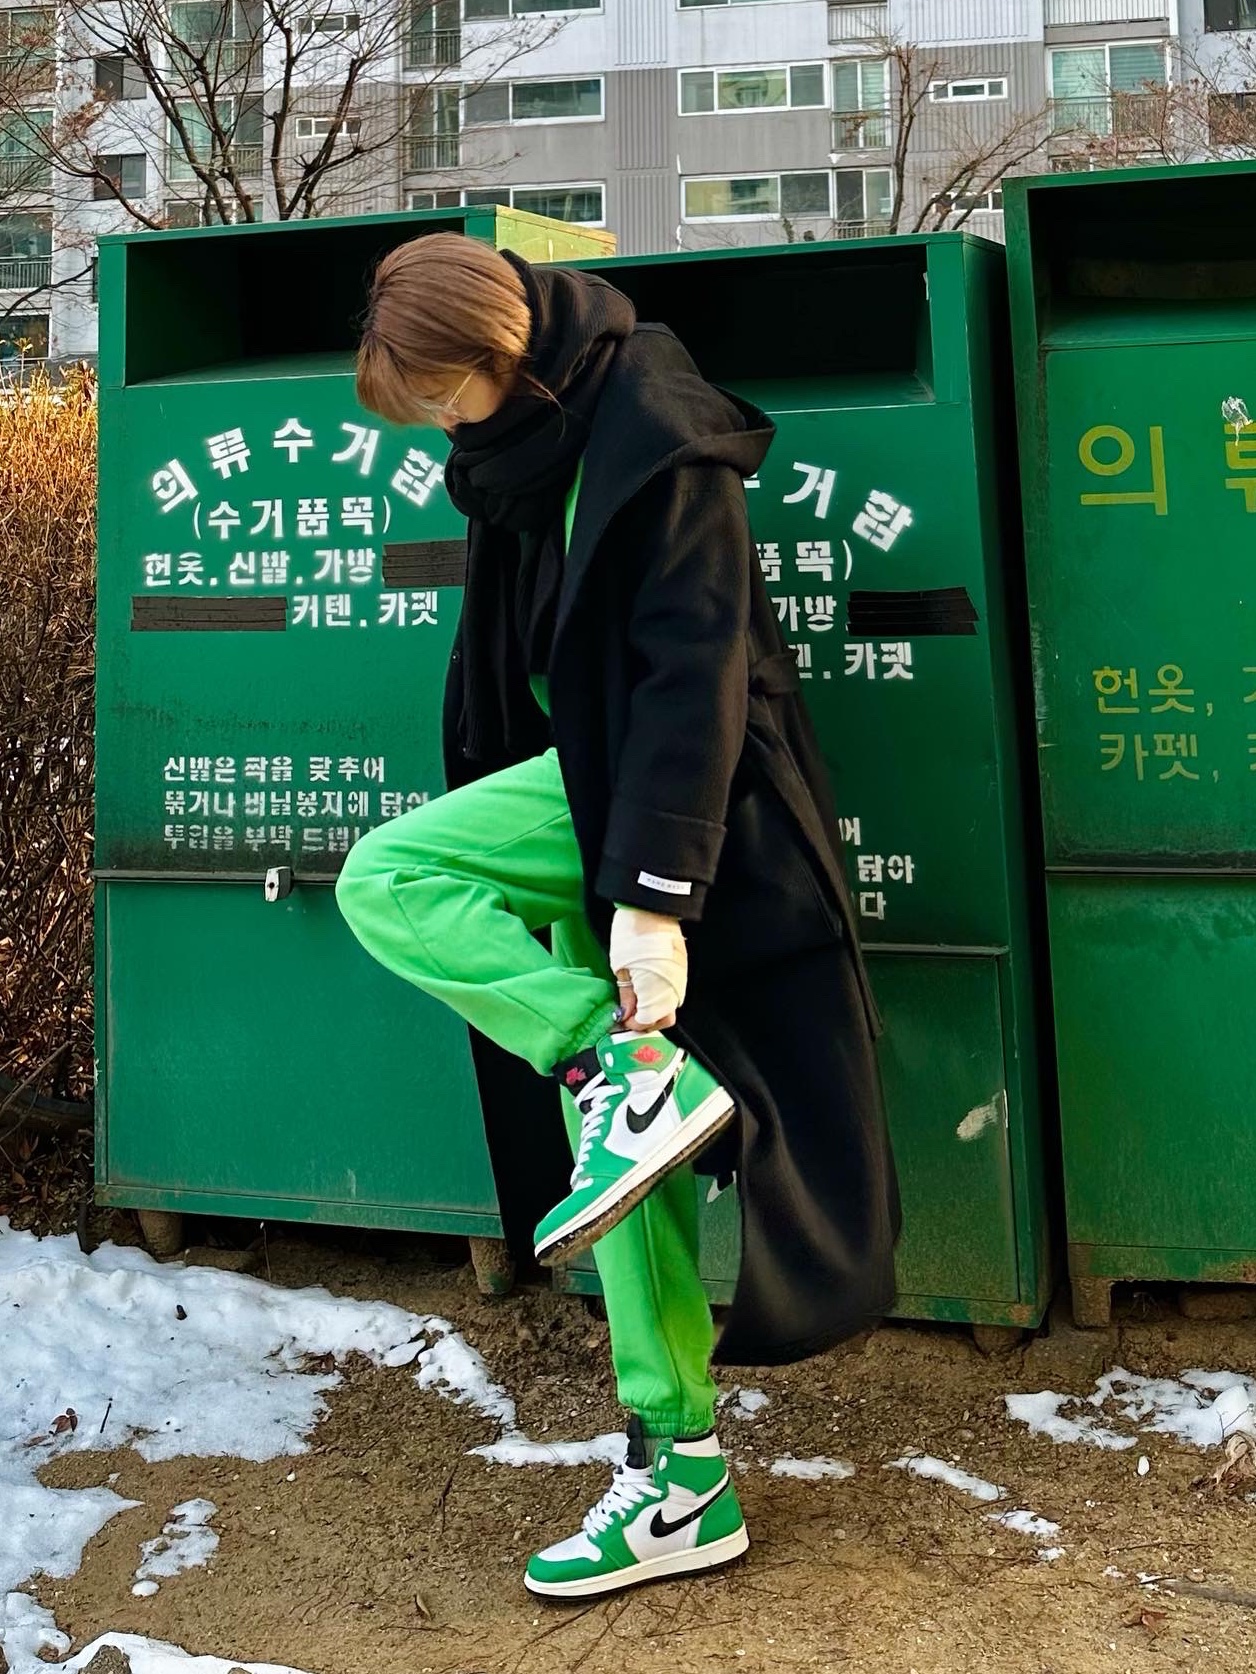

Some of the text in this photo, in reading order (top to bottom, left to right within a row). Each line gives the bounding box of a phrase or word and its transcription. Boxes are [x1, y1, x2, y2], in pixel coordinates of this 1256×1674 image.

[193, 495, 391, 541] (수거품목)
[743, 461, 914, 552] 거함
[378, 590, 438, 627] 카펫
[843, 641, 914, 681] 카펫
[164, 756, 237, 783] 신발은
[244, 756, 293, 783] 짝을
[164, 790, 236, 817] 묶거나
[164, 824, 234, 851] 투입을
[244, 824, 293, 852] 부탁
[857, 854, 915, 884] 담아
